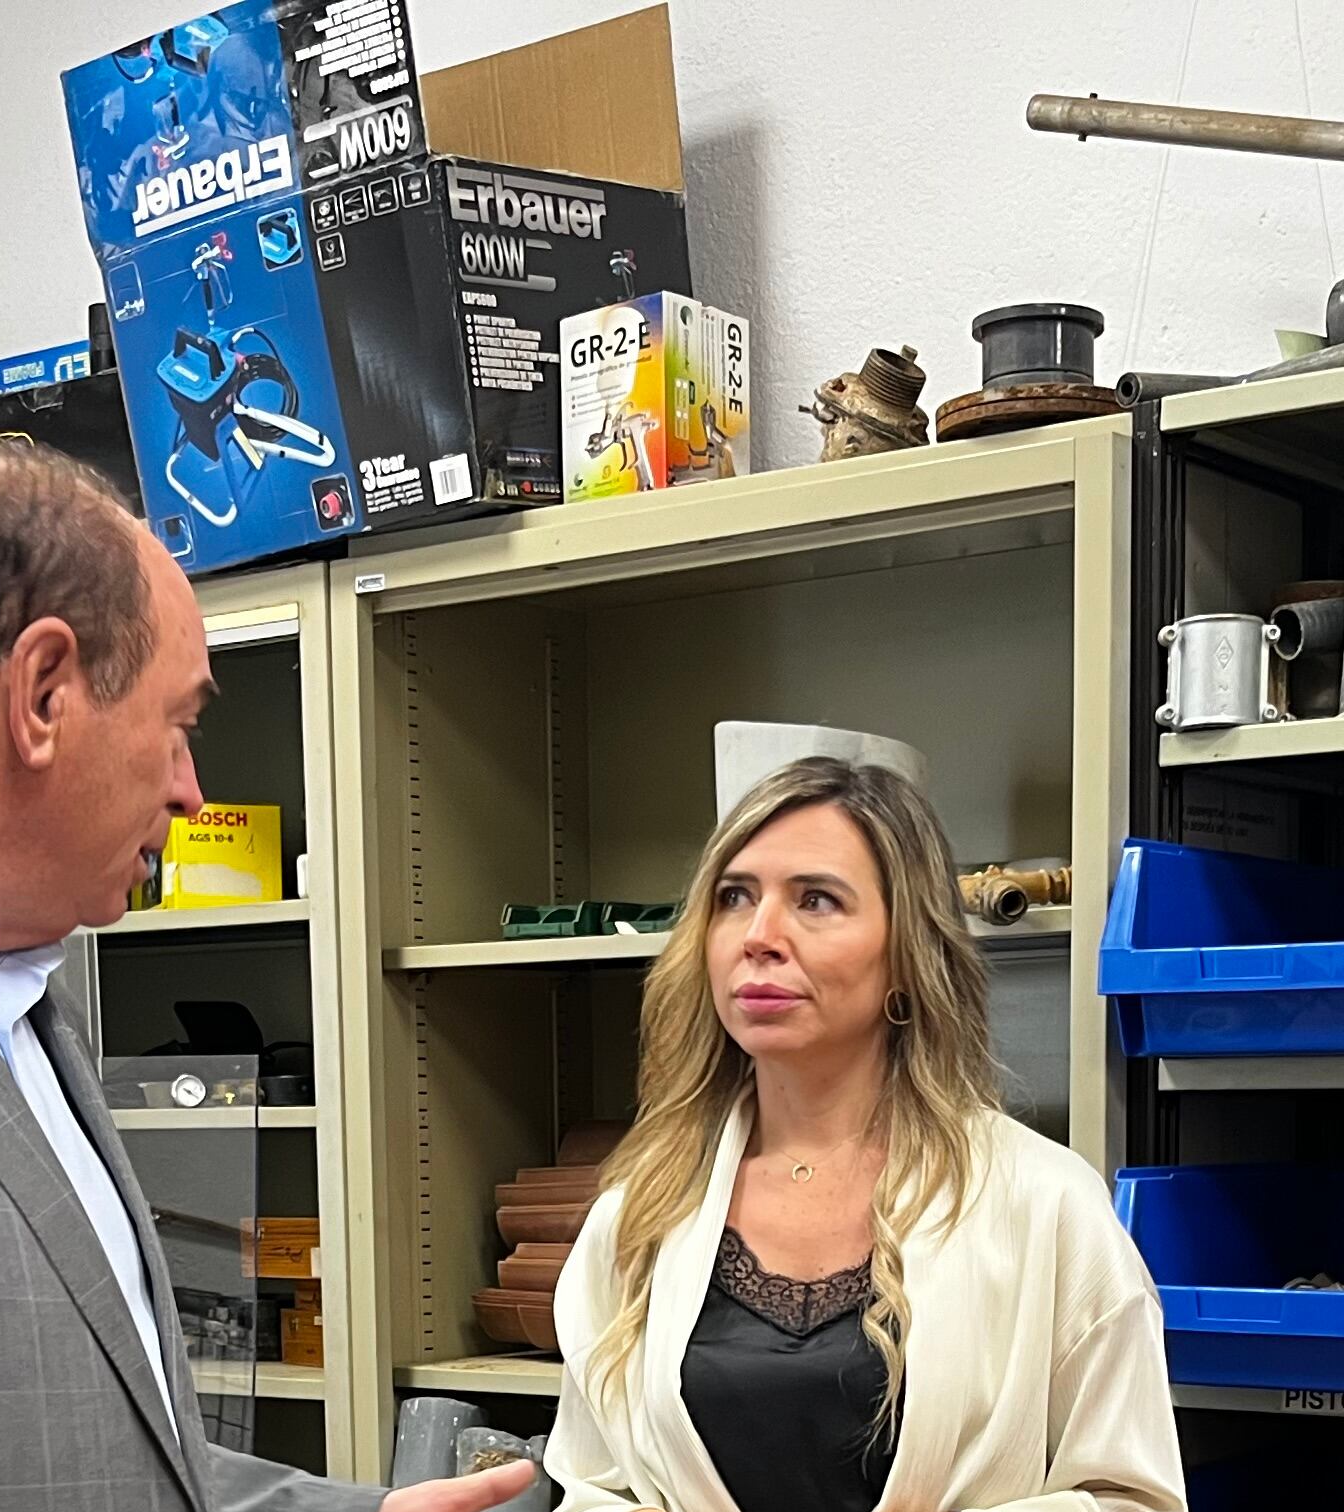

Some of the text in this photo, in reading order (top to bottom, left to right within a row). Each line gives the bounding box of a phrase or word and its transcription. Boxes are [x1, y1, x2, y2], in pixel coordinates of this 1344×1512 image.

[339, 107, 412, 171] 600W
[132, 133, 293, 228] Erbauer
[448, 167, 607, 240] Erbauer
[460, 233, 528, 279] 600W
[570, 320, 652, 368] GR-2-E
[727, 323, 744, 415] GR-2-E
[372, 454, 406, 477] Year
